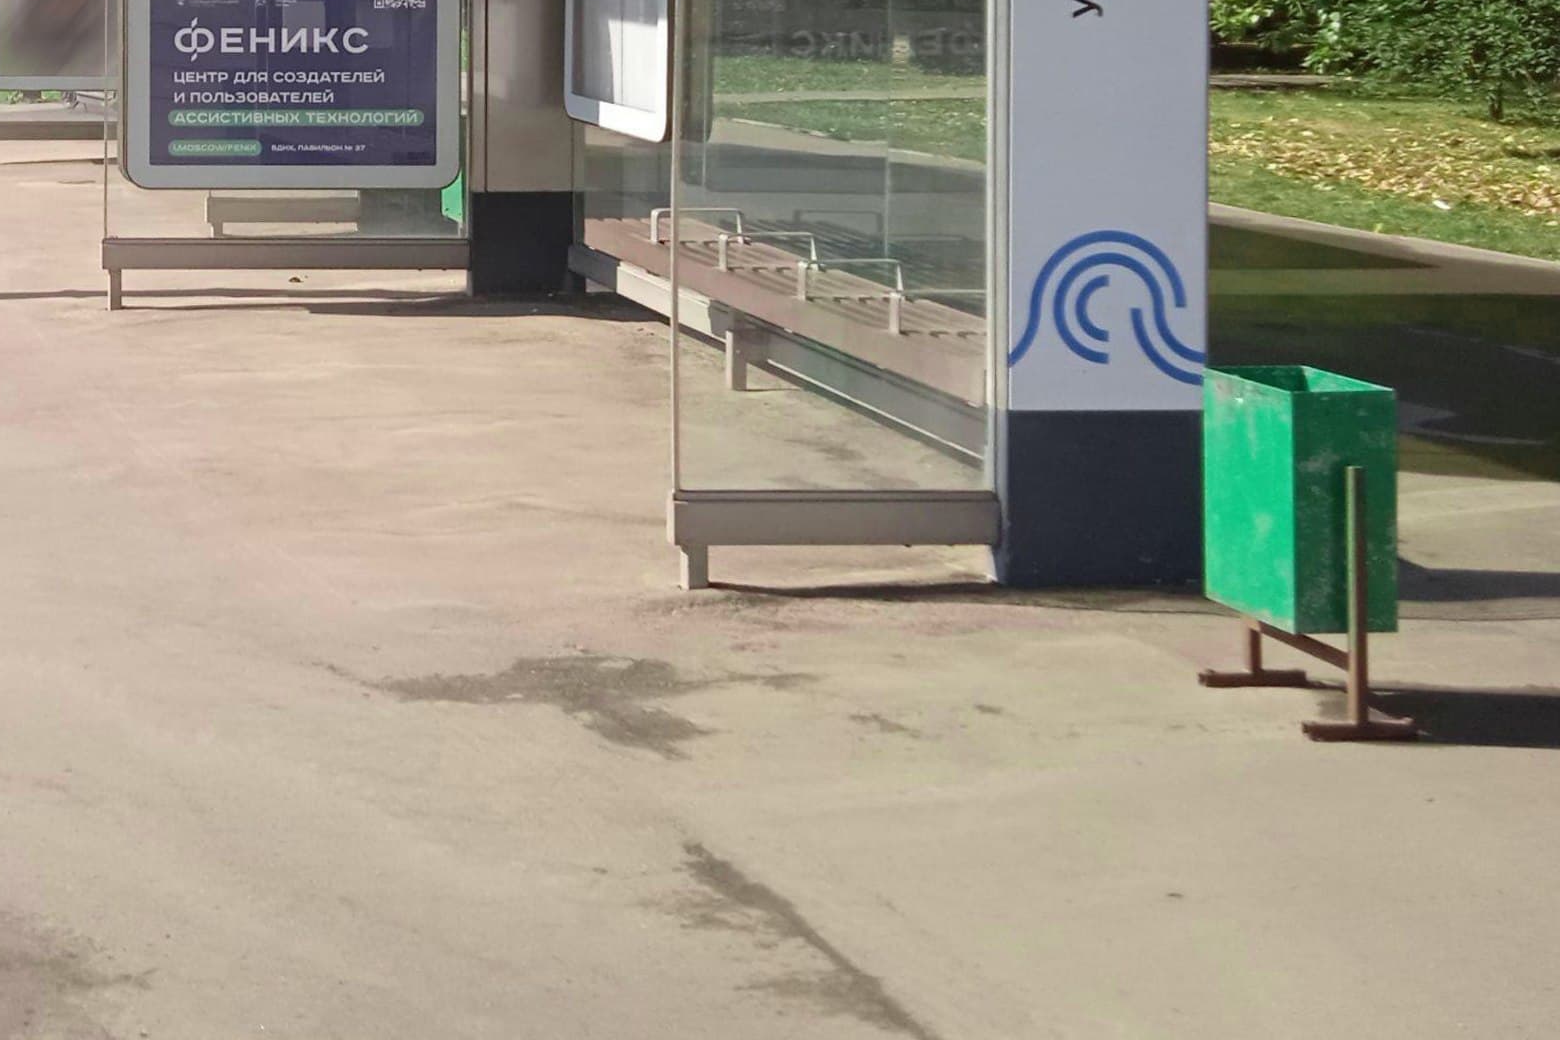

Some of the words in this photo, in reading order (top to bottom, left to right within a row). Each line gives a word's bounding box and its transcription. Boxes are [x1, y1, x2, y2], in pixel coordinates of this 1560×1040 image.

[174, 17, 370, 62] ФЕНИКС
[173, 71, 229, 85] ЦЕНТР
[233, 71, 268, 85] ДЛЯ
[272, 68, 385, 85] СОЗДАТЕЛЕЙ
[173, 91, 186, 103] И
[189, 88, 335, 104] ПОЛЬЗОВАТЕЛЕЙ
[174, 111, 300, 124] АССИСТИВНЫХ
[305, 109, 419, 124] ТЕХНОЛОГИЙ
